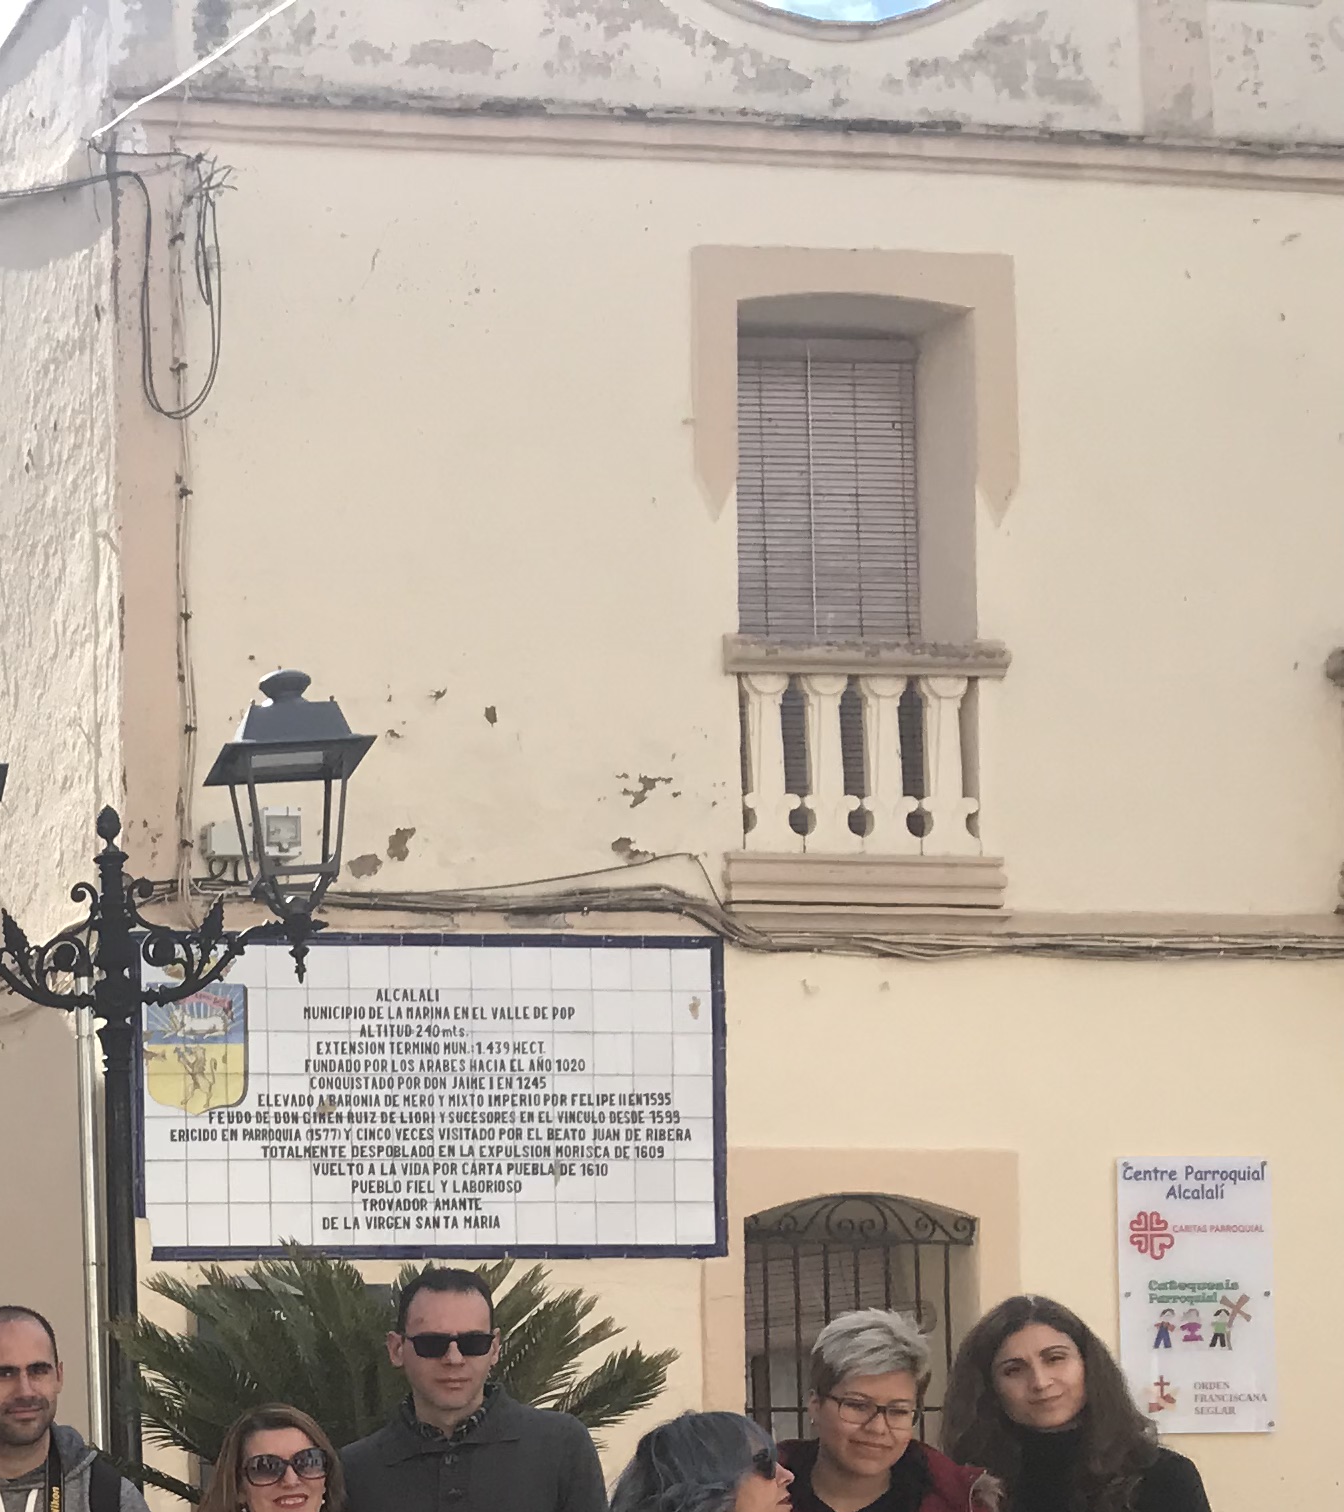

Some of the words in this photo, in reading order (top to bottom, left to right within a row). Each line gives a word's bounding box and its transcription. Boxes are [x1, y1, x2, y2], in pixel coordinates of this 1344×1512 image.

[375, 988, 440, 1002] ALCALALI
[303, 1006, 366, 1020] MUNICIPIO
[368, 1006, 385, 1020] DE
[387, 1006, 404, 1020] LA
[406, 1006, 451, 1020] MARINA
[453, 1006, 470, 1020] EN
[472, 1006, 488, 1020] EL
[491, 1006, 531, 1020] VALLE
[533, 1006, 549, 1020] DE
[552, 1006, 576, 1020] POP
[316, 1041, 386, 1055] EXTENSION
[389, 1041, 440, 1055] TERMINO
[512, 1041, 546, 1055] HECT.
[304, 1059, 361, 1073] FUNDADO
[364, 1059, 388, 1073] POR
[391, 1059, 415, 1073] LOS
[419, 1059, 466, 1073] ARABES
[469, 1059, 507, 1073] HACIA
[510, 1059, 525, 1073] EL
[528, 1055, 553, 1073] AÑO
[555, 1059, 586, 1073] 1020
[310, 1076, 394, 1090] CONQUISTADO
[397, 1076, 421, 1090] POR
[424, 1076, 447, 1090] DON
[451, 1076, 485, 1090] JAIME
[489, 1076, 495, 1090] I
[497, 1076, 513, 1090] EN
[515, 1076, 547, 1090] 1245
[257, 1093, 314, 1107] ELEVADO
[318, 1093, 326, 1107] A
[328, 1093, 381, 1107] BARONIA
[384, 1093, 400, 1107] DE
[402, 1093, 435, 1107] MERO
[438, 1093, 445, 1107] Y
[448, 1093, 485, 1107] MIXTO
[487, 1093, 541, 1107] IMPERIO
[543, 1093, 568, 1107] POR
[571, 1093, 616, 1107] FELIPE
[208, 1111, 252, 1124] FEUDO
[255, 1111, 270, 1124] DE
[274, 1111, 299, 1124] DON
[347, 1111, 377, 1124] RUIZ
[380, 1111, 396, 1124] DE
[400, 1111, 435, 1124] LIORI
[439, 1111, 446, 1124] Y
[448, 1111, 516, 1124] SUCESORES
[520, 1111, 535, 1124] EN
[537, 1111, 554, 1124] EL
[557, 1111, 606, 1124] VINCULO
[609, 1111, 645, 1124] DESDE
[648, 1111, 681, 1124] 1599
[221, 1128, 238, 1142] EN
[242, 1128, 302, 1142] PARROQUIA
[305, 1128, 342, 1142] (1577)
[343, 1128, 352, 1142] Y
[356, 1128, 392, 1142] CINCO
[395, 1128, 434, 1142] VECES
[438, 1128, 496, 1142] VISITADO
[498, 1128, 523, 1142] POR
[527, 1128, 543, 1142] EL
[547, 1128, 586, 1142] BEATO
[592, 1128, 620, 1142] JUAN
[625, 1128, 642, 1142] DE
[646, 1128, 692, 1142] RIBERA
[261, 1145, 347, 1159] TOTALMENTE
[352, 1145, 435, 1159] DESPOBLADO
[438, 1145, 456, 1159] EN
[459, 1145, 475, 1159] LA
[479, 1145, 551, 1159] EXPULSION
[555, 1145, 610, 1159] MORISCA
[614, 1145, 631, 1159] DE
[634, 1145, 665, 1159] 1609
[313, 1162, 364, 1176] VUELTO
[368, 1162, 376, 1176] A
[380, 1162, 397, 1176] LA
[401, 1162, 430, 1176] VIDA
[433, 1162, 458, 1176] POR
[461, 1162, 503, 1176] CARTA
[506, 1162, 555, 1176] PUEBLA
[560, 1162, 576, 1176] DE
[579, 1162, 609, 1176] 1610
[1122, 1165, 1178, 1182] Centre
[1184, 1163, 1266, 1185] Parroquial
[351, 1180, 402, 1194] PUEBLO
[406, 1180, 435, 1194] FIEL
[440, 1180, 449, 1194] Y
[453, 1180, 522, 1194] LABORIOSO
[1165, 1184, 1225, 1200] Alcalalí
[362, 1198, 428, 1212] TROVADOR
[434, 1198, 483, 1212] AMANTE
[322, 1216, 339, 1230] DE
[344, 1216, 361, 1230] LA
[365, 1216, 411, 1230] VIRGEN
[463, 1216, 501, 1230] MARIA
[1209, 1225, 1265, 1233] PARROQUIAL
[1148, 1279, 1240, 1292] Catequesis
[1148, 1292, 1218, 1305] Parroquial
[1193, 1381, 1230, 1390] ORDEN
[1193, 1392, 1268, 1403] FRANCISCANA
[1194, 1405, 1237, 1415] SEGLAR
